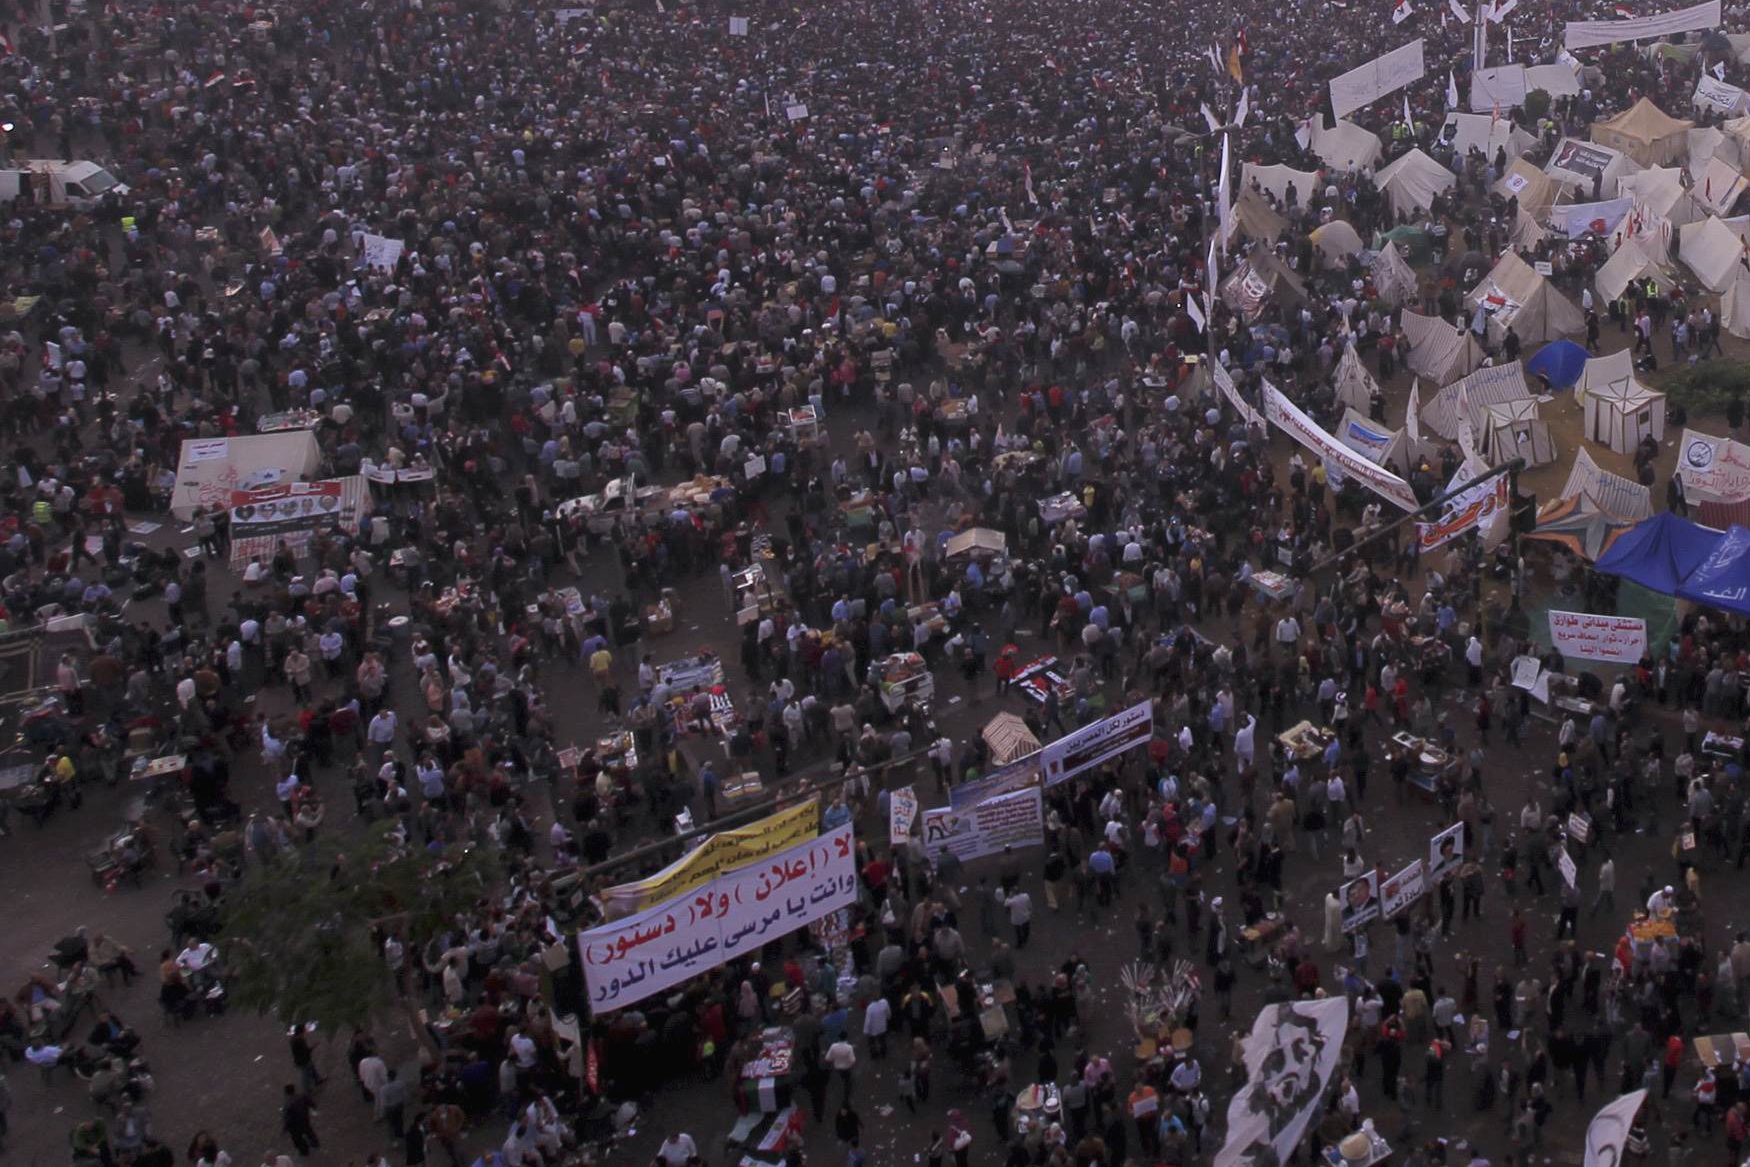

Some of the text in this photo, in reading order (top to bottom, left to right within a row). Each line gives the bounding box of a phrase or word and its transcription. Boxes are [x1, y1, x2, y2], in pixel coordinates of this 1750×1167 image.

[1611, 618, 1643, 632] مستشفى
[834, 831, 851, 858] لا
[594, 874, 855, 1002] وانت يا مرسى عليك الدور
